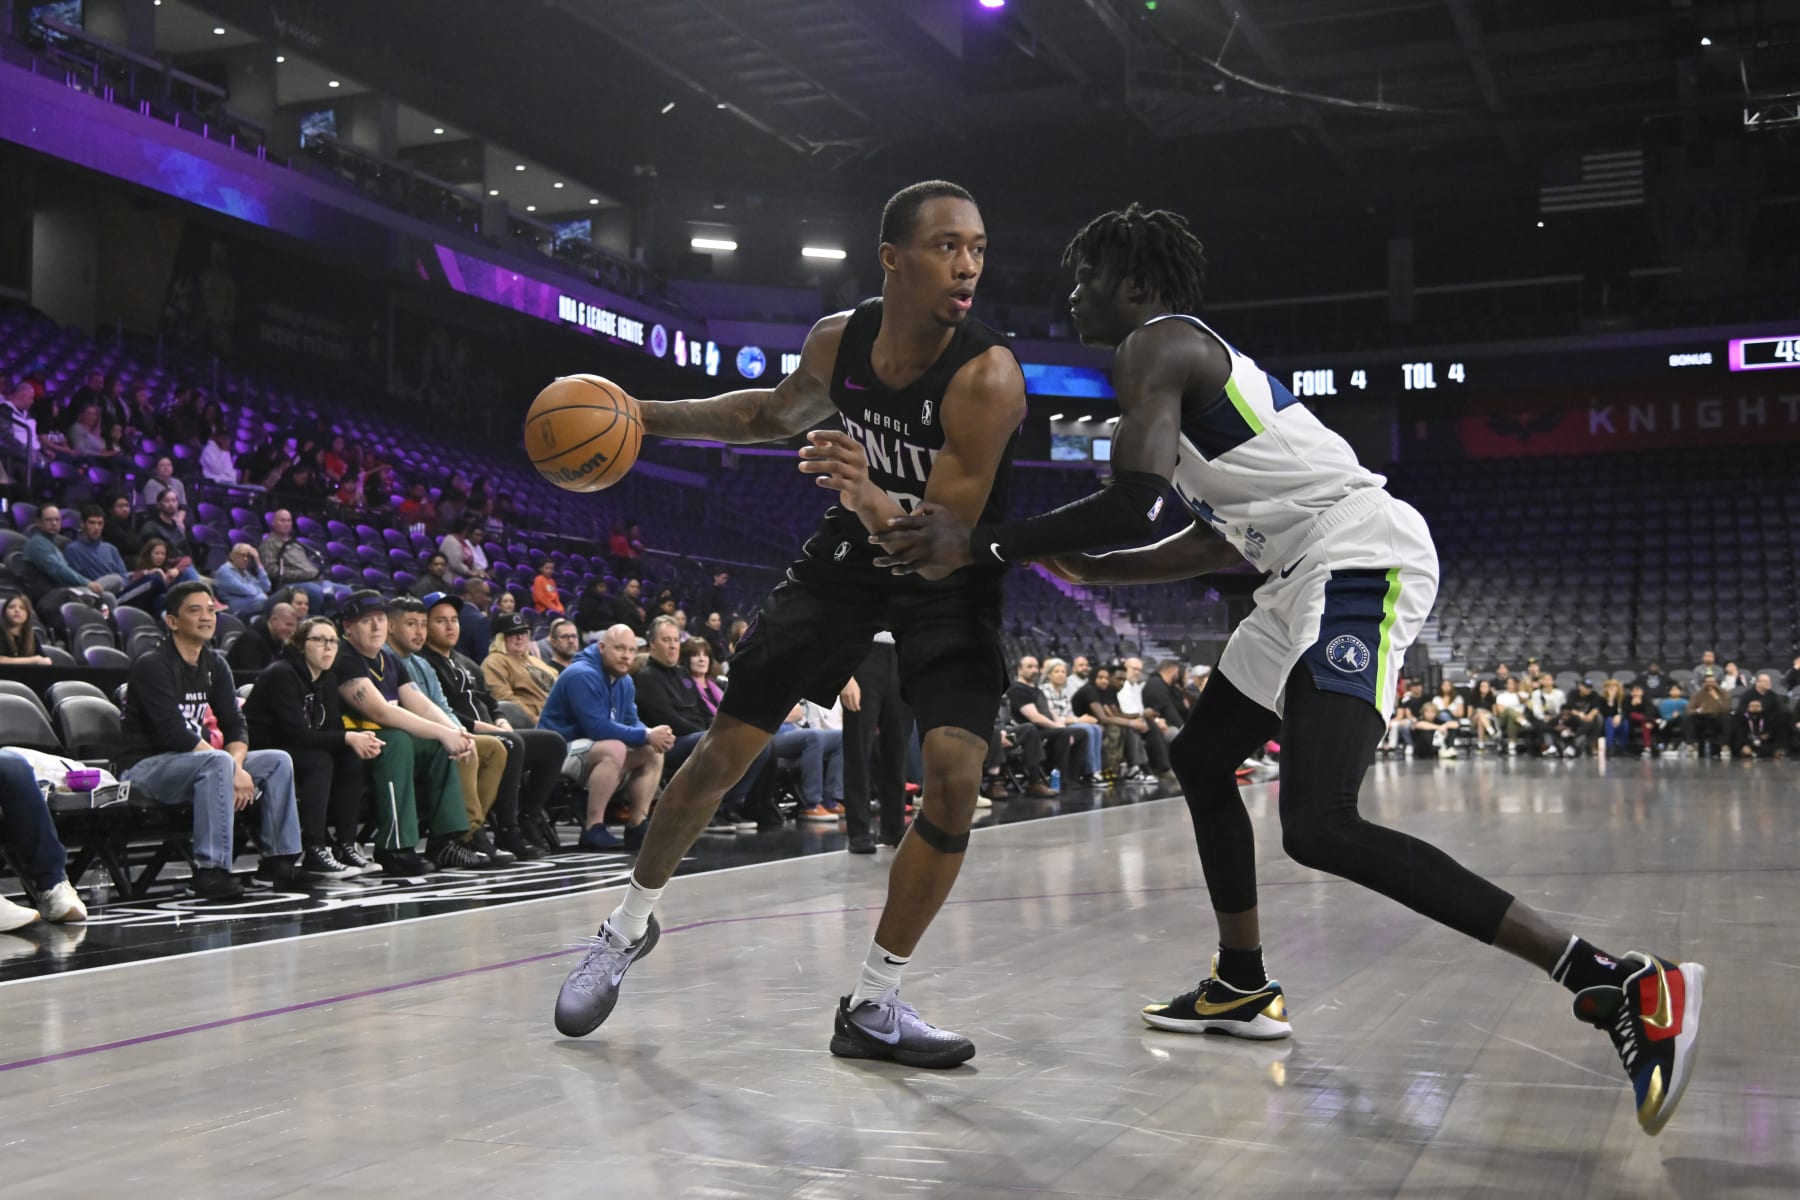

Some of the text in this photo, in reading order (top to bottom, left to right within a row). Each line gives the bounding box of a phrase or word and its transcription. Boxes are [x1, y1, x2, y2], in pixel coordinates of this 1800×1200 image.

[586, 305, 617, 337] LEAGUE
[690, 340, 702, 366] VS
[1668, 352, 1713, 367] BONUS
[1293, 361, 1466, 397] FOUL 4 TOL 4
[864, 408, 911, 436] NBAGL
